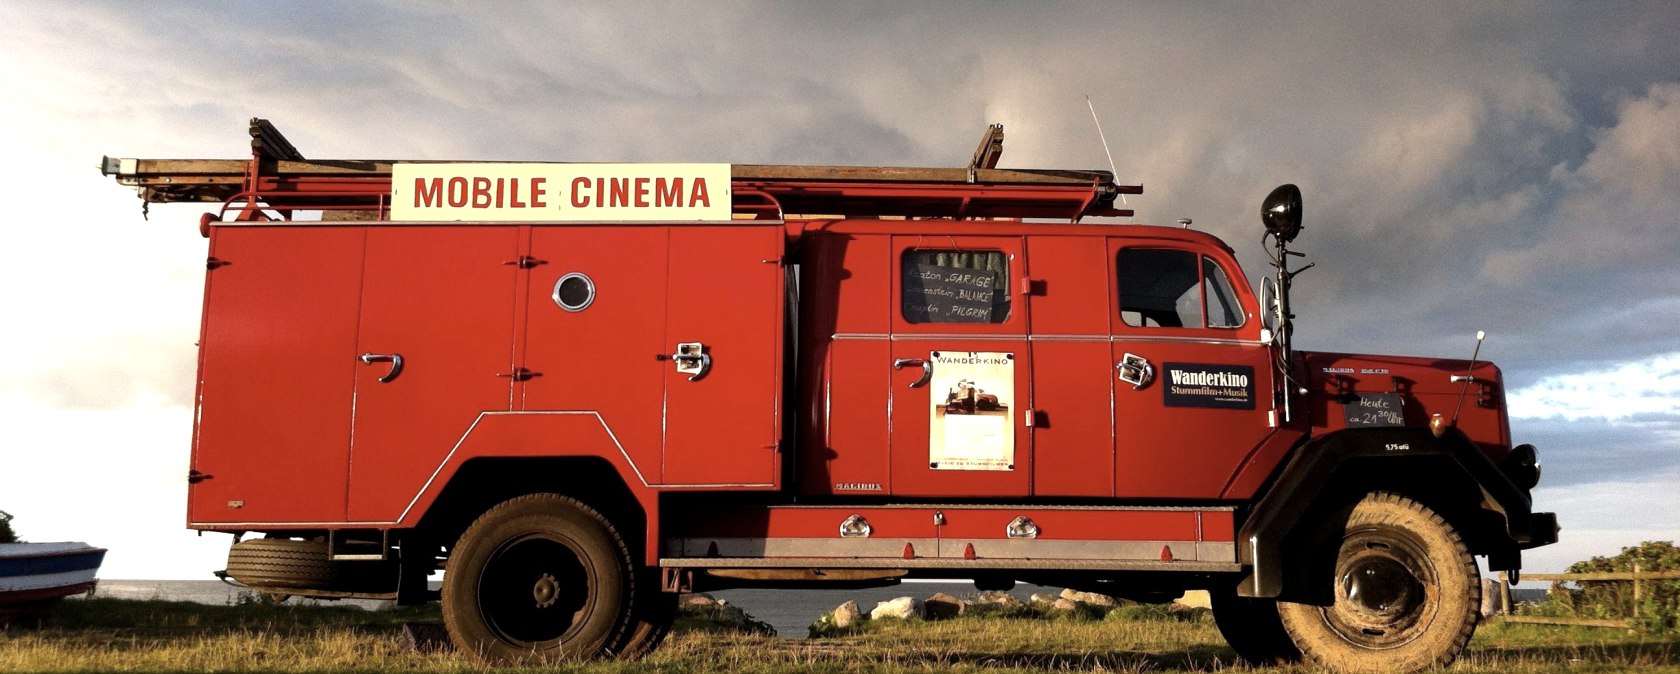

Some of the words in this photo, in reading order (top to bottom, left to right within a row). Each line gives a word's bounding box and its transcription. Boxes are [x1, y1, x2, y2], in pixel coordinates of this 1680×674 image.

[413, 176, 547, 209] MOBILE
[570, 176, 711, 208] CINEMA
[936, 357, 1009, 365] WANDERKINO
[1170, 369, 1249, 388] Wanderkino
[1170, 385, 1249, 398] Stummfilm+Musik
[1360, 396, 1390, 409] Heute
